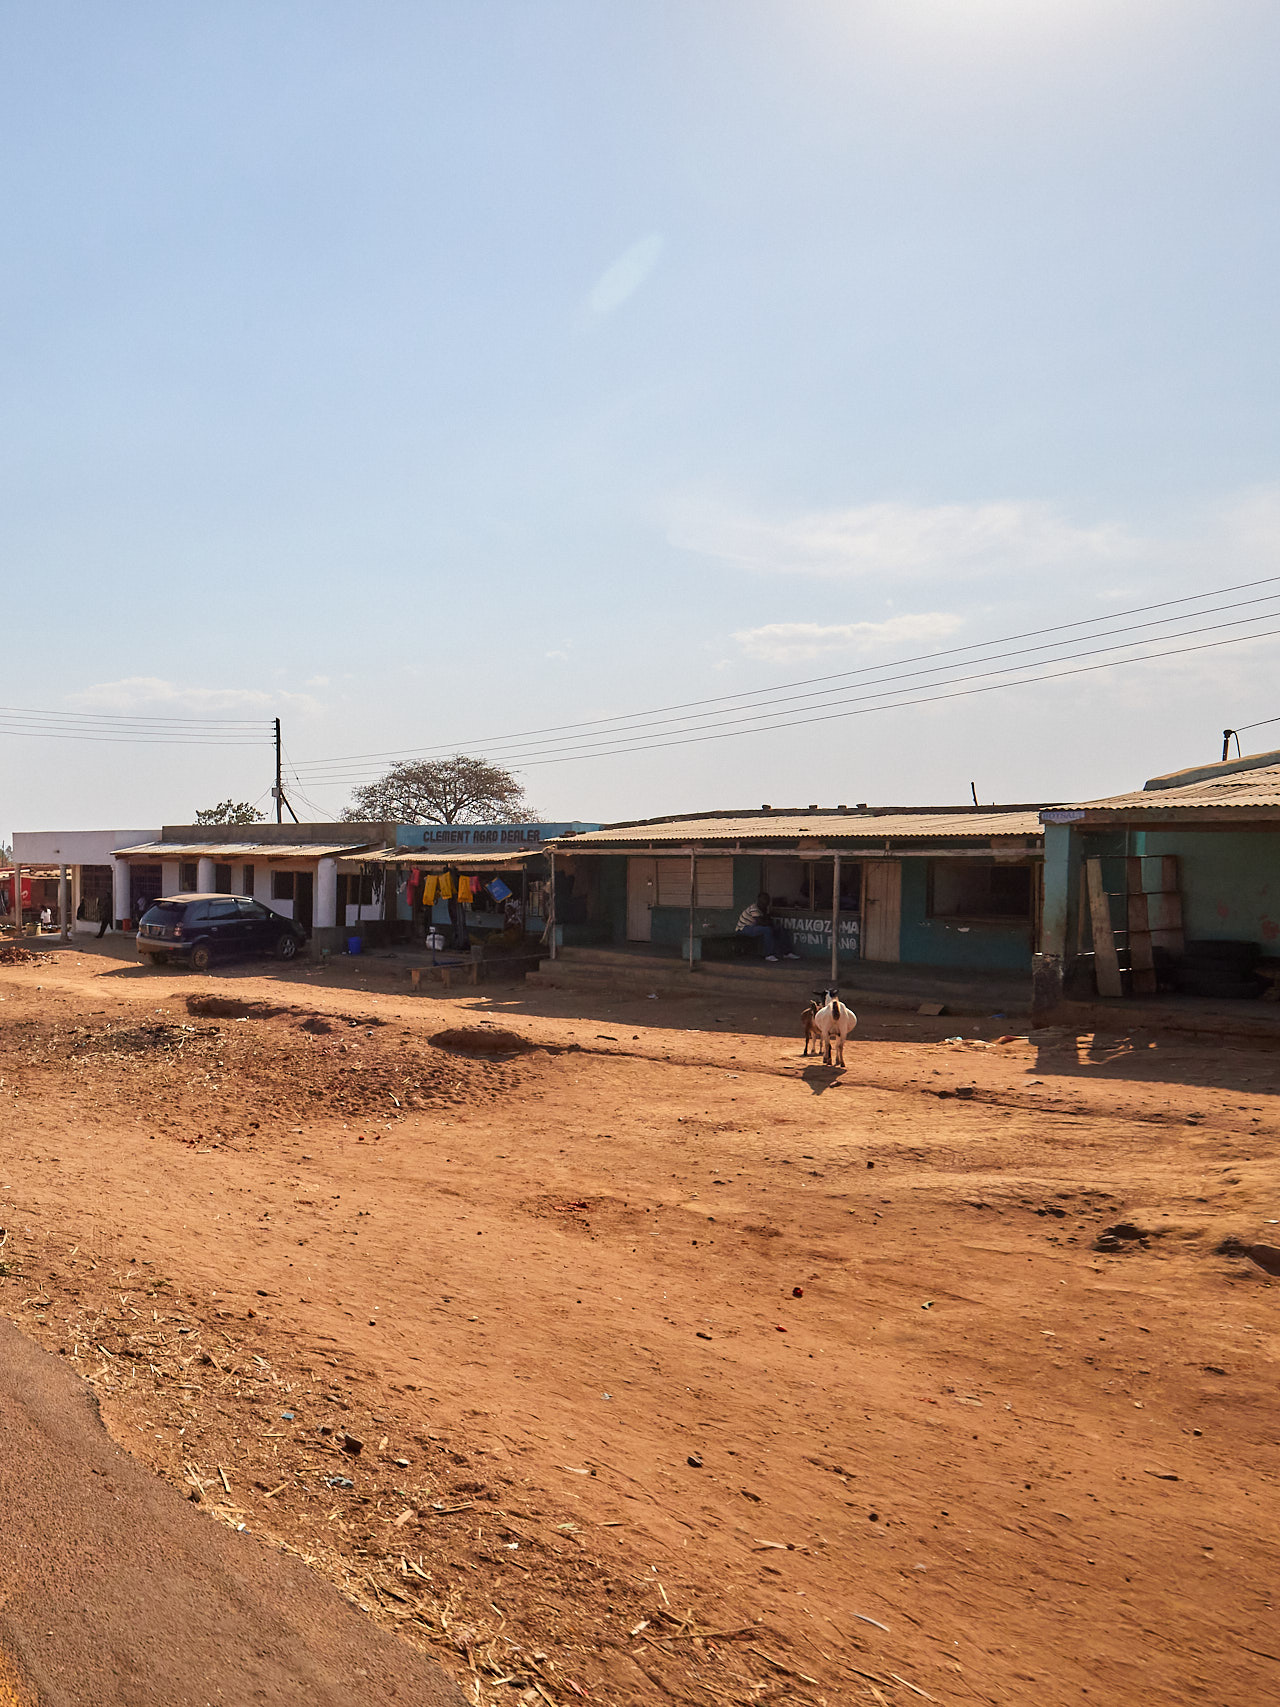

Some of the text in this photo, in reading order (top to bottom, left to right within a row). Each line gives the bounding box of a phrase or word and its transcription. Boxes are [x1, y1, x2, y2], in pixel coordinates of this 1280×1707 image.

[423, 829, 540, 843] CLEMENT AGRO DEALER
